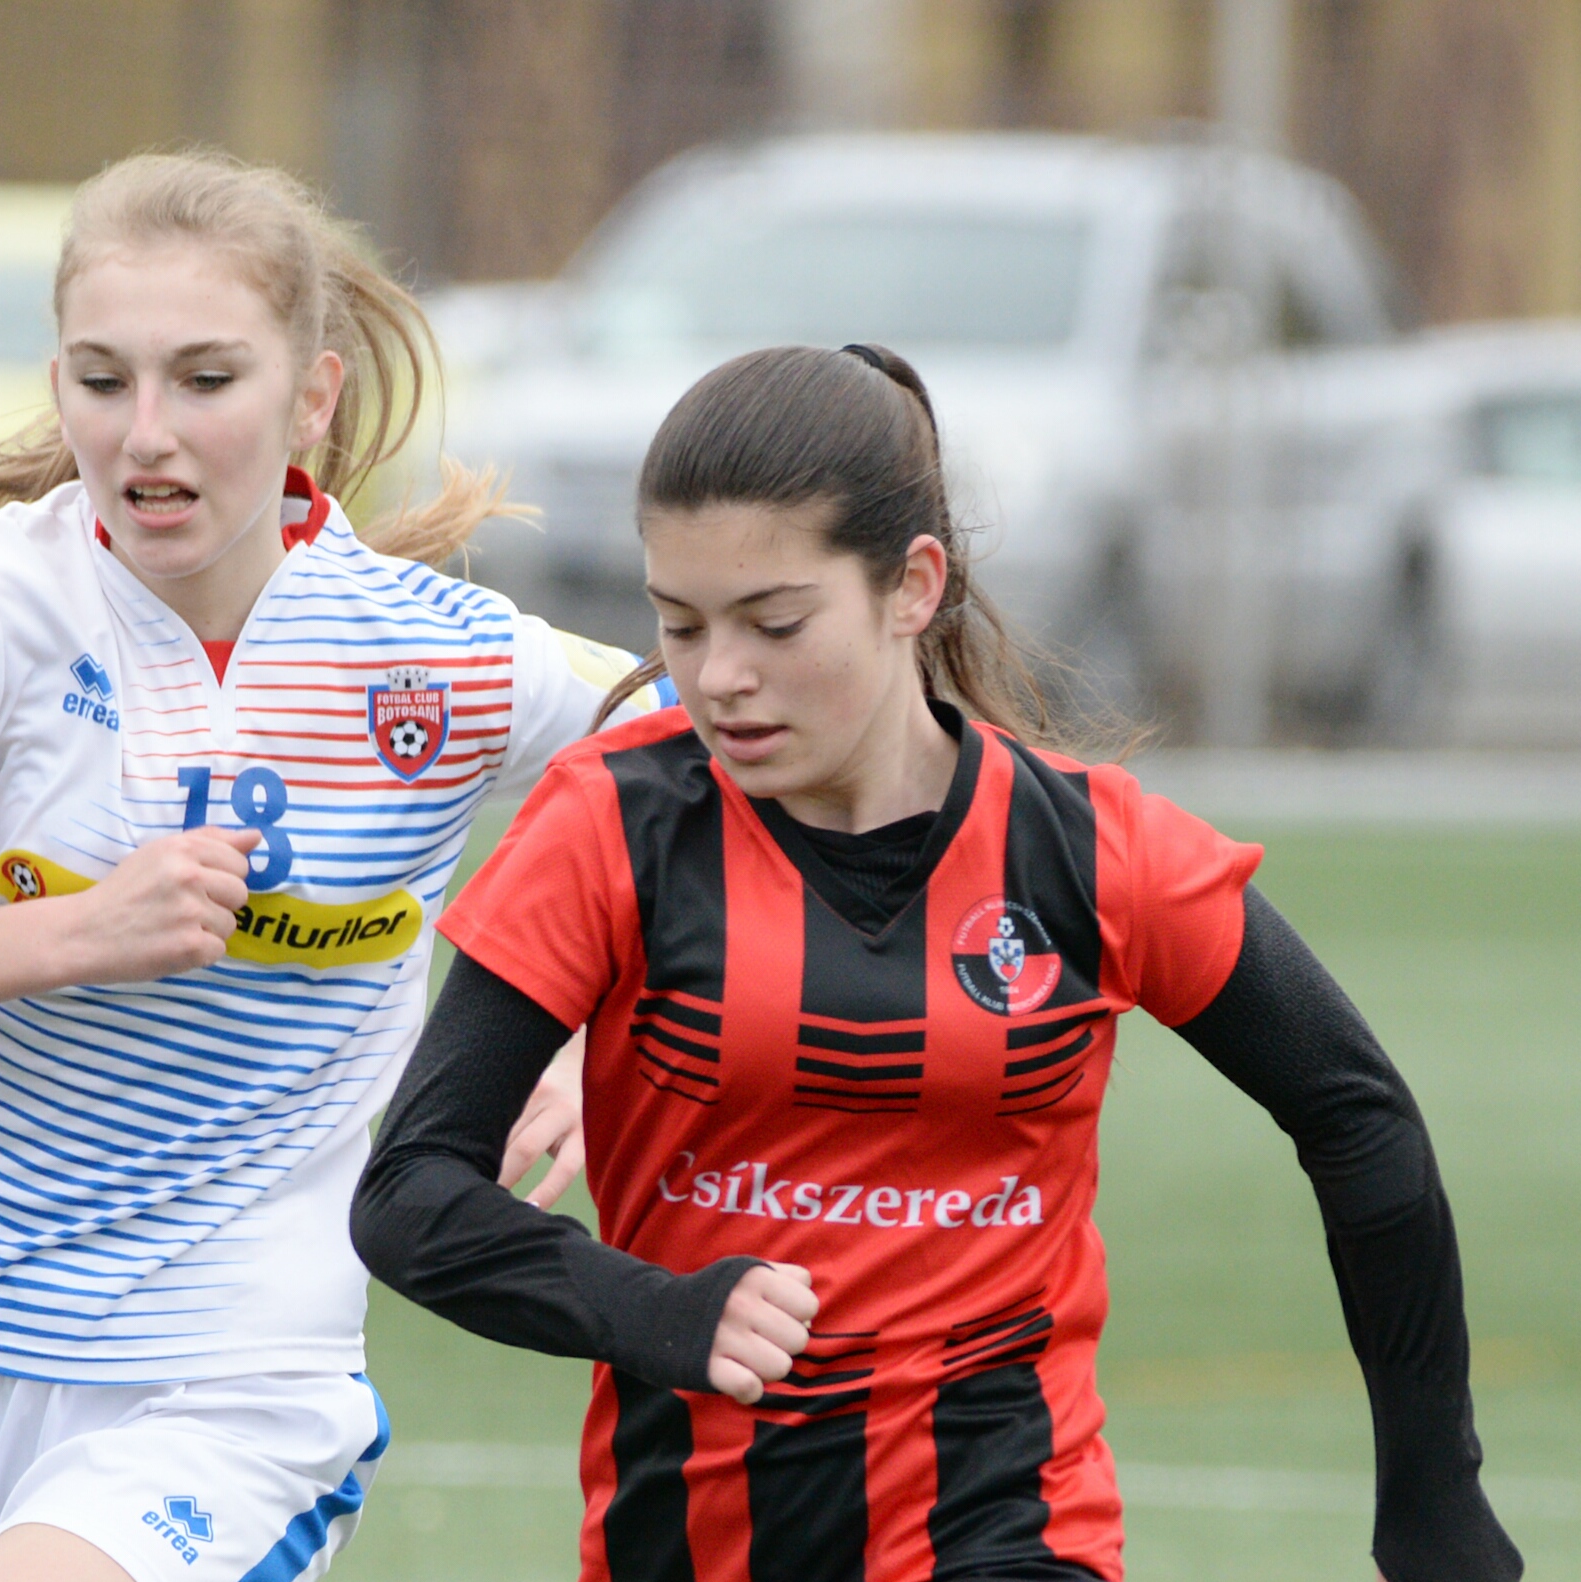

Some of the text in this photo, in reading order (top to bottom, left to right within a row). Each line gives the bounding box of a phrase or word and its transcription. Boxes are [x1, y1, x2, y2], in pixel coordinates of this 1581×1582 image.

[62, 692, 119, 732] errea
[377, 691, 440, 705] FOTBAL CLUB
[377, 705, 440, 727] BOTOSANI
[177, 766, 293, 891] 18
[234, 905, 408, 950] ariurilor
[657, 1150, 1044, 1229] Csíkszereda
[141, 1510, 199, 1566] errea
